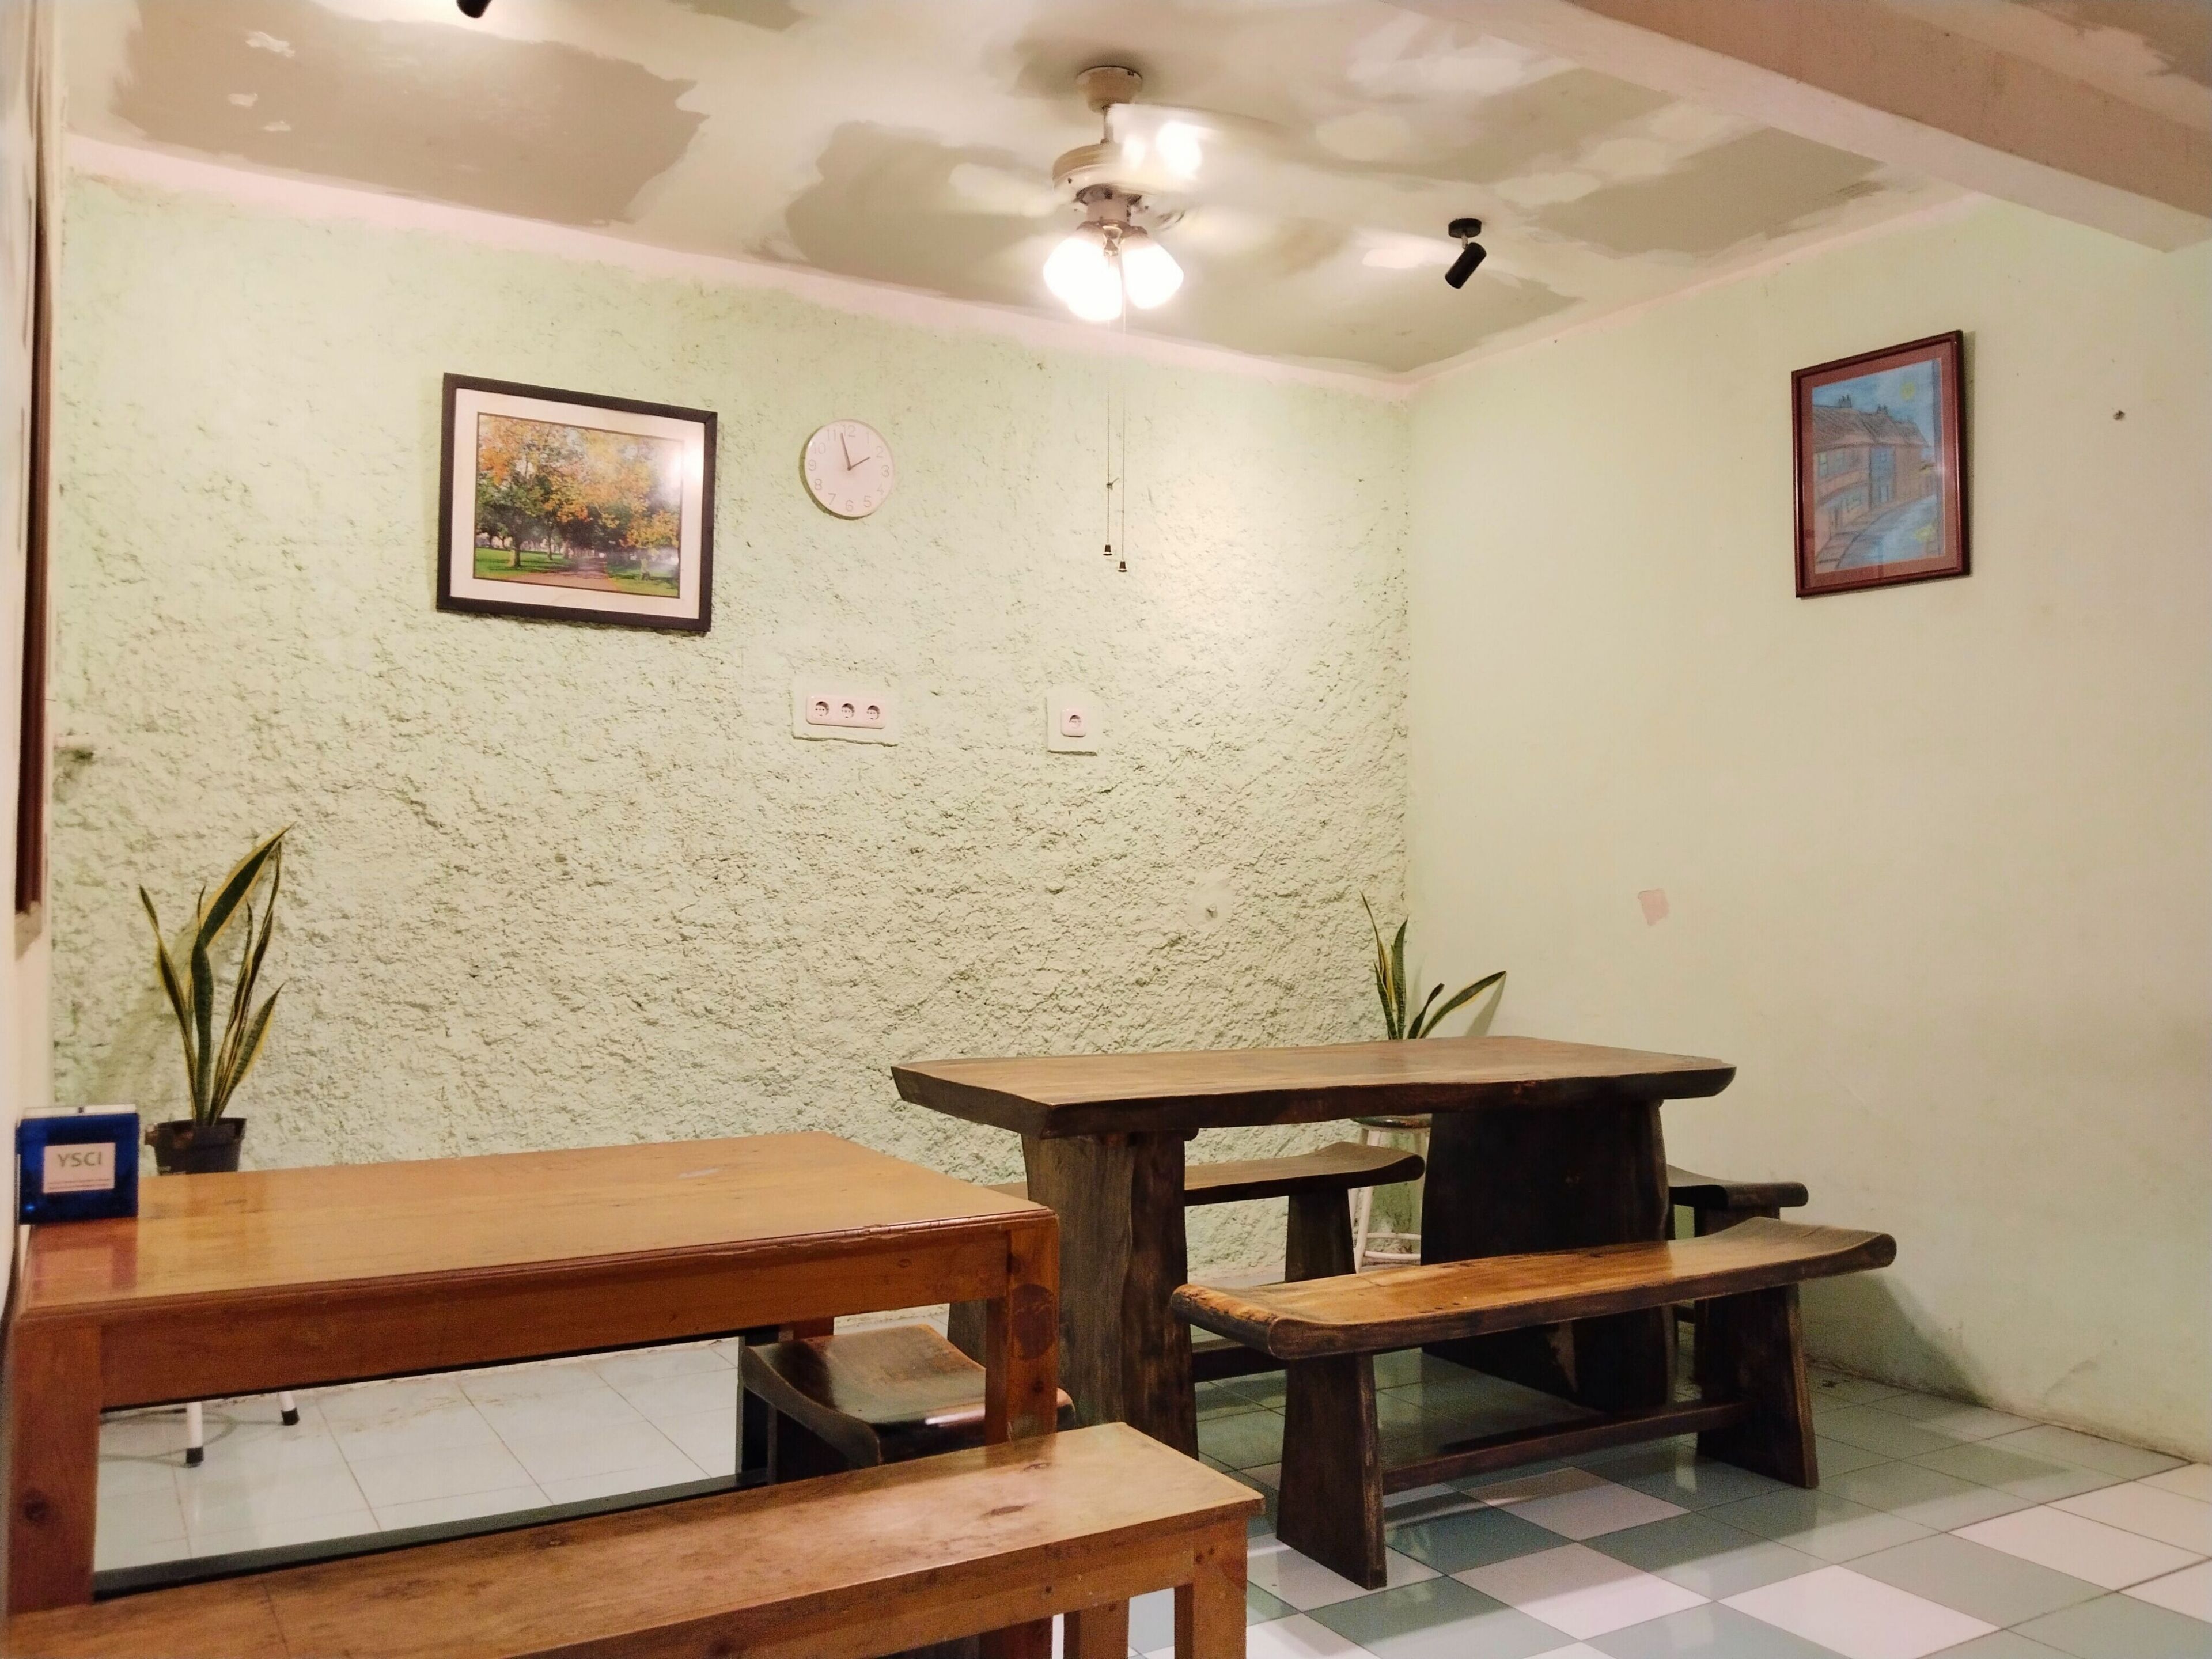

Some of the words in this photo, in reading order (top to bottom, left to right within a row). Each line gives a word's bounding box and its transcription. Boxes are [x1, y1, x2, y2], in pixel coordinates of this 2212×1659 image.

[876, 446, 884, 459] 2
[808, 460, 816, 471] 9
[881, 465, 889, 478] 3
[814, 479, 823, 490] 8
[877, 483, 884, 495] 4
[828, 493, 836, 505] 7
[863, 495, 872, 507] 5
[846, 499, 854, 512] 6
[56, 1151, 102, 1168] YSCI
